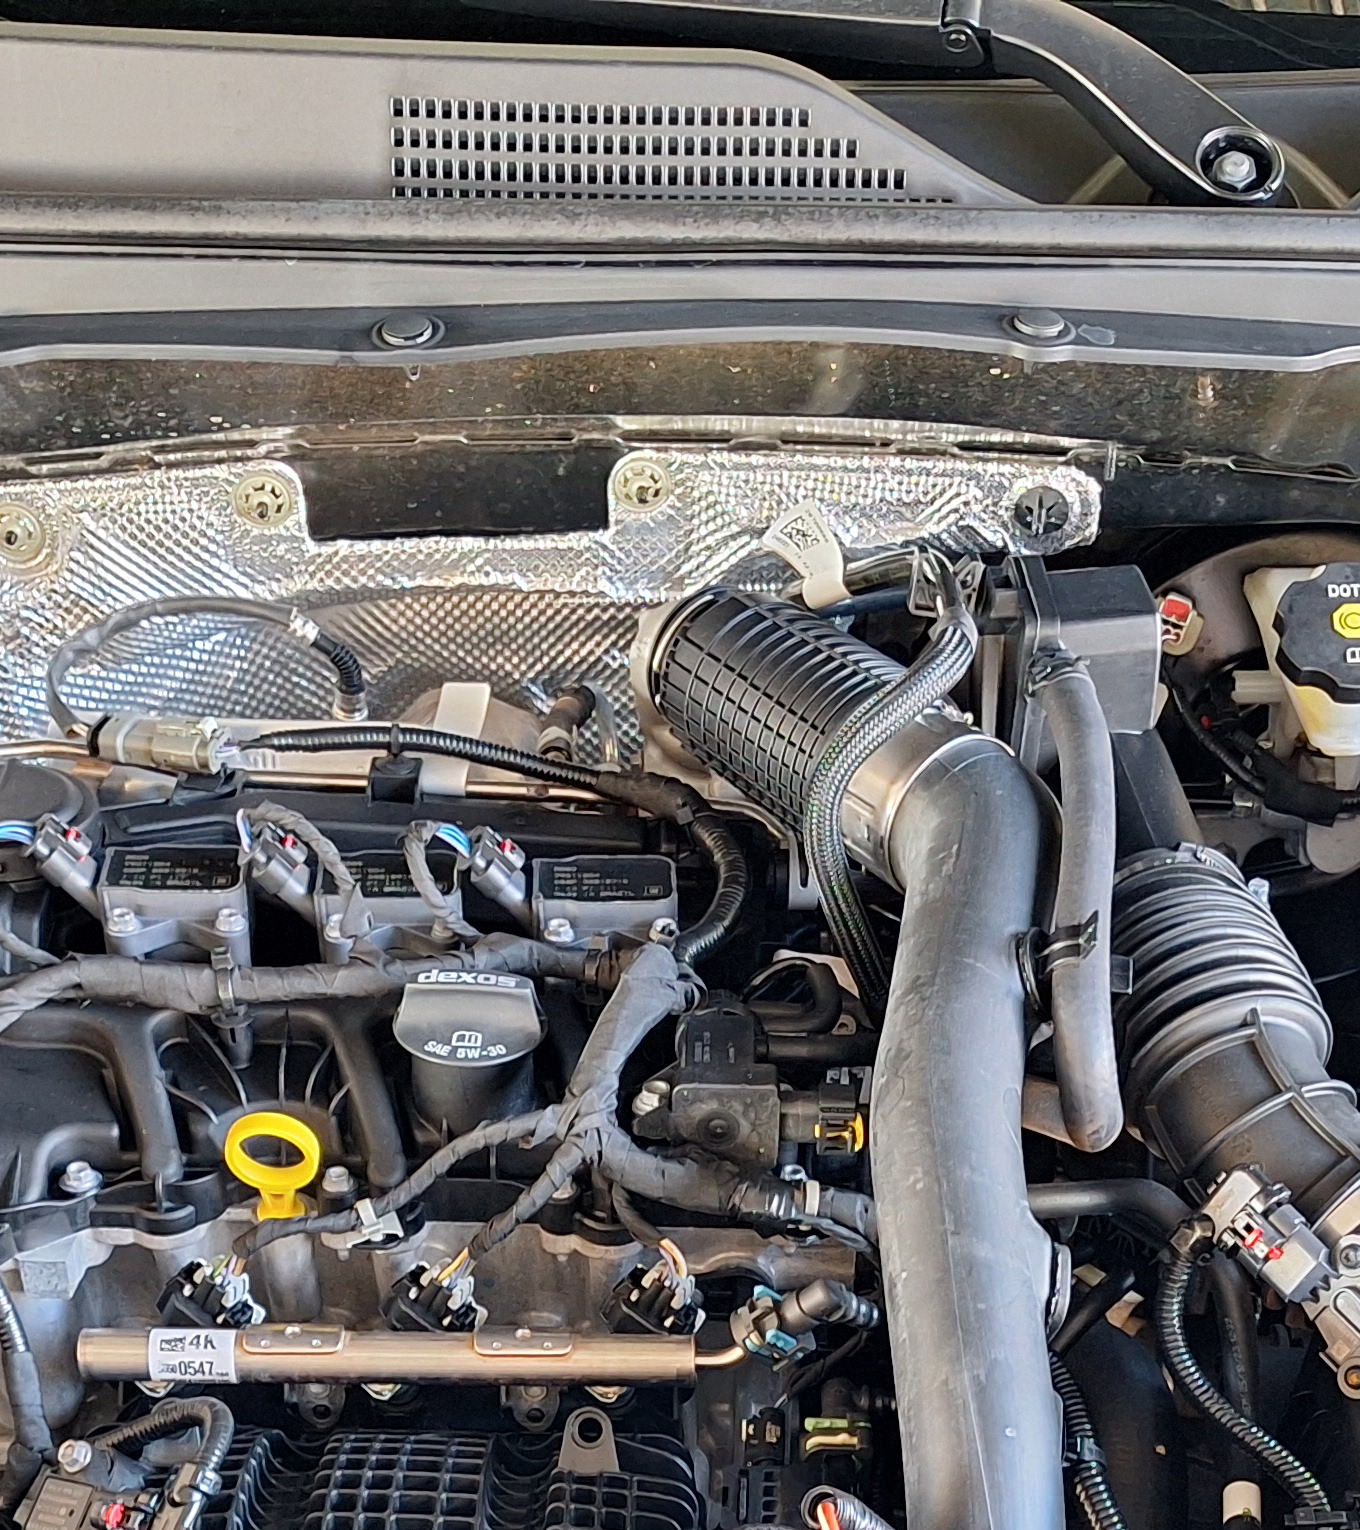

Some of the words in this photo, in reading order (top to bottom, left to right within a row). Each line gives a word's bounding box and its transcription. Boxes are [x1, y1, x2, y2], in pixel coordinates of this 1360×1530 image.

[1327, 583, 1360, 598] DOT
[417, 969, 517, 988] dexos
[423, 1040, 452, 1057] SAE
[456, 1044, 507, 1060] 5W-30
[188, 1334, 217, 1350] 4K
